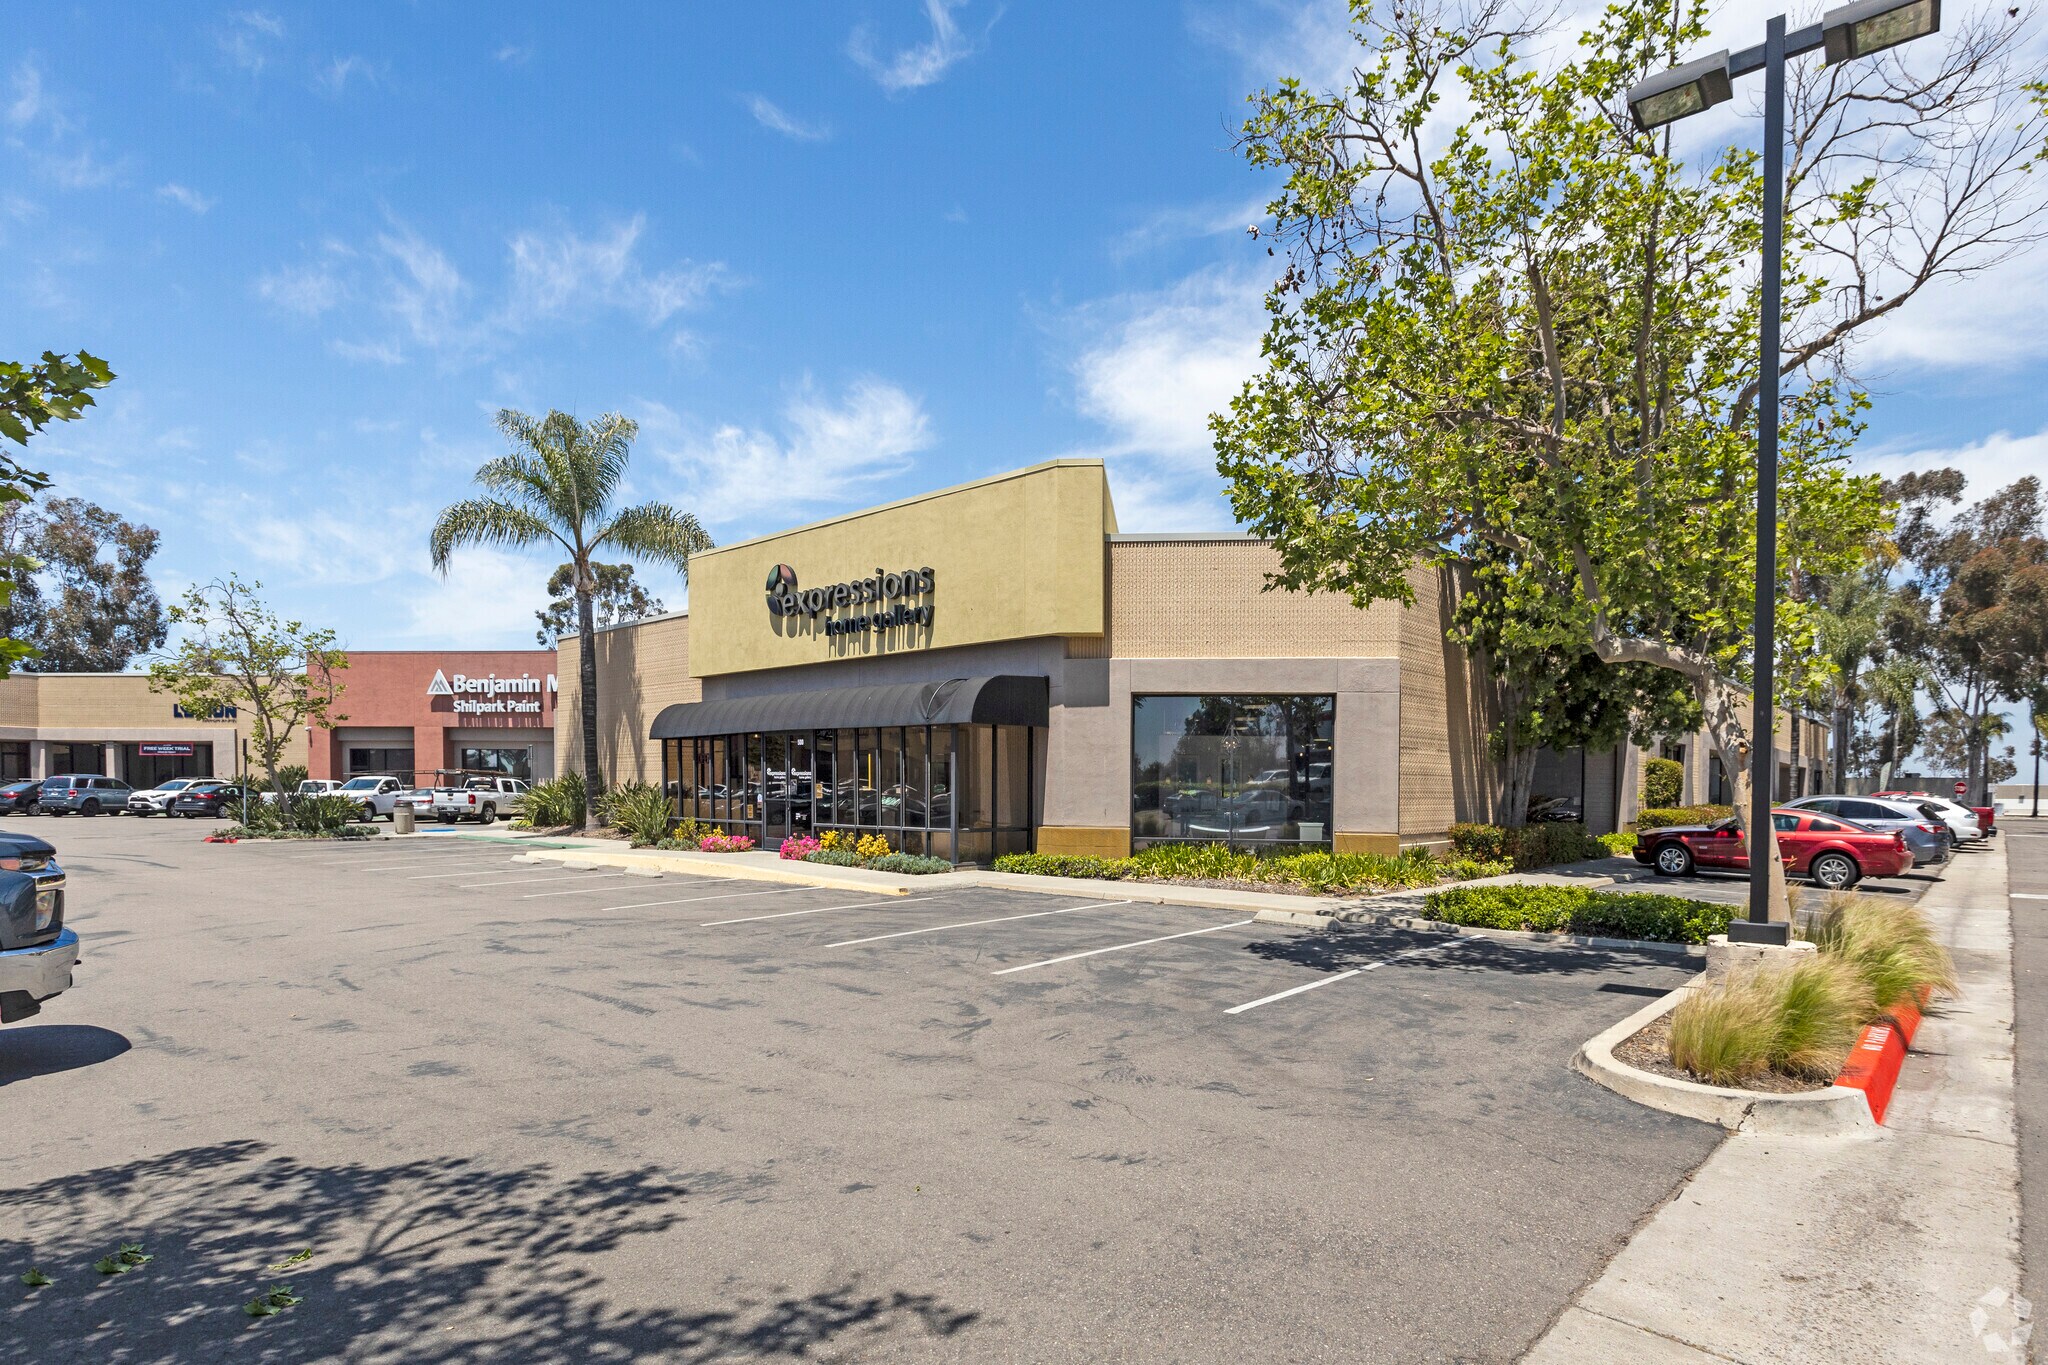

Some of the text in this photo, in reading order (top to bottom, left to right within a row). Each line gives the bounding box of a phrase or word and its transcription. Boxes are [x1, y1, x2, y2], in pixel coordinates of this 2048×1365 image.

[783, 566, 935, 619] expressions
[825, 604, 935, 636] home gallery
[453, 673, 541, 698] Benjamin
[453, 699, 540, 715] Shilpark Paint
